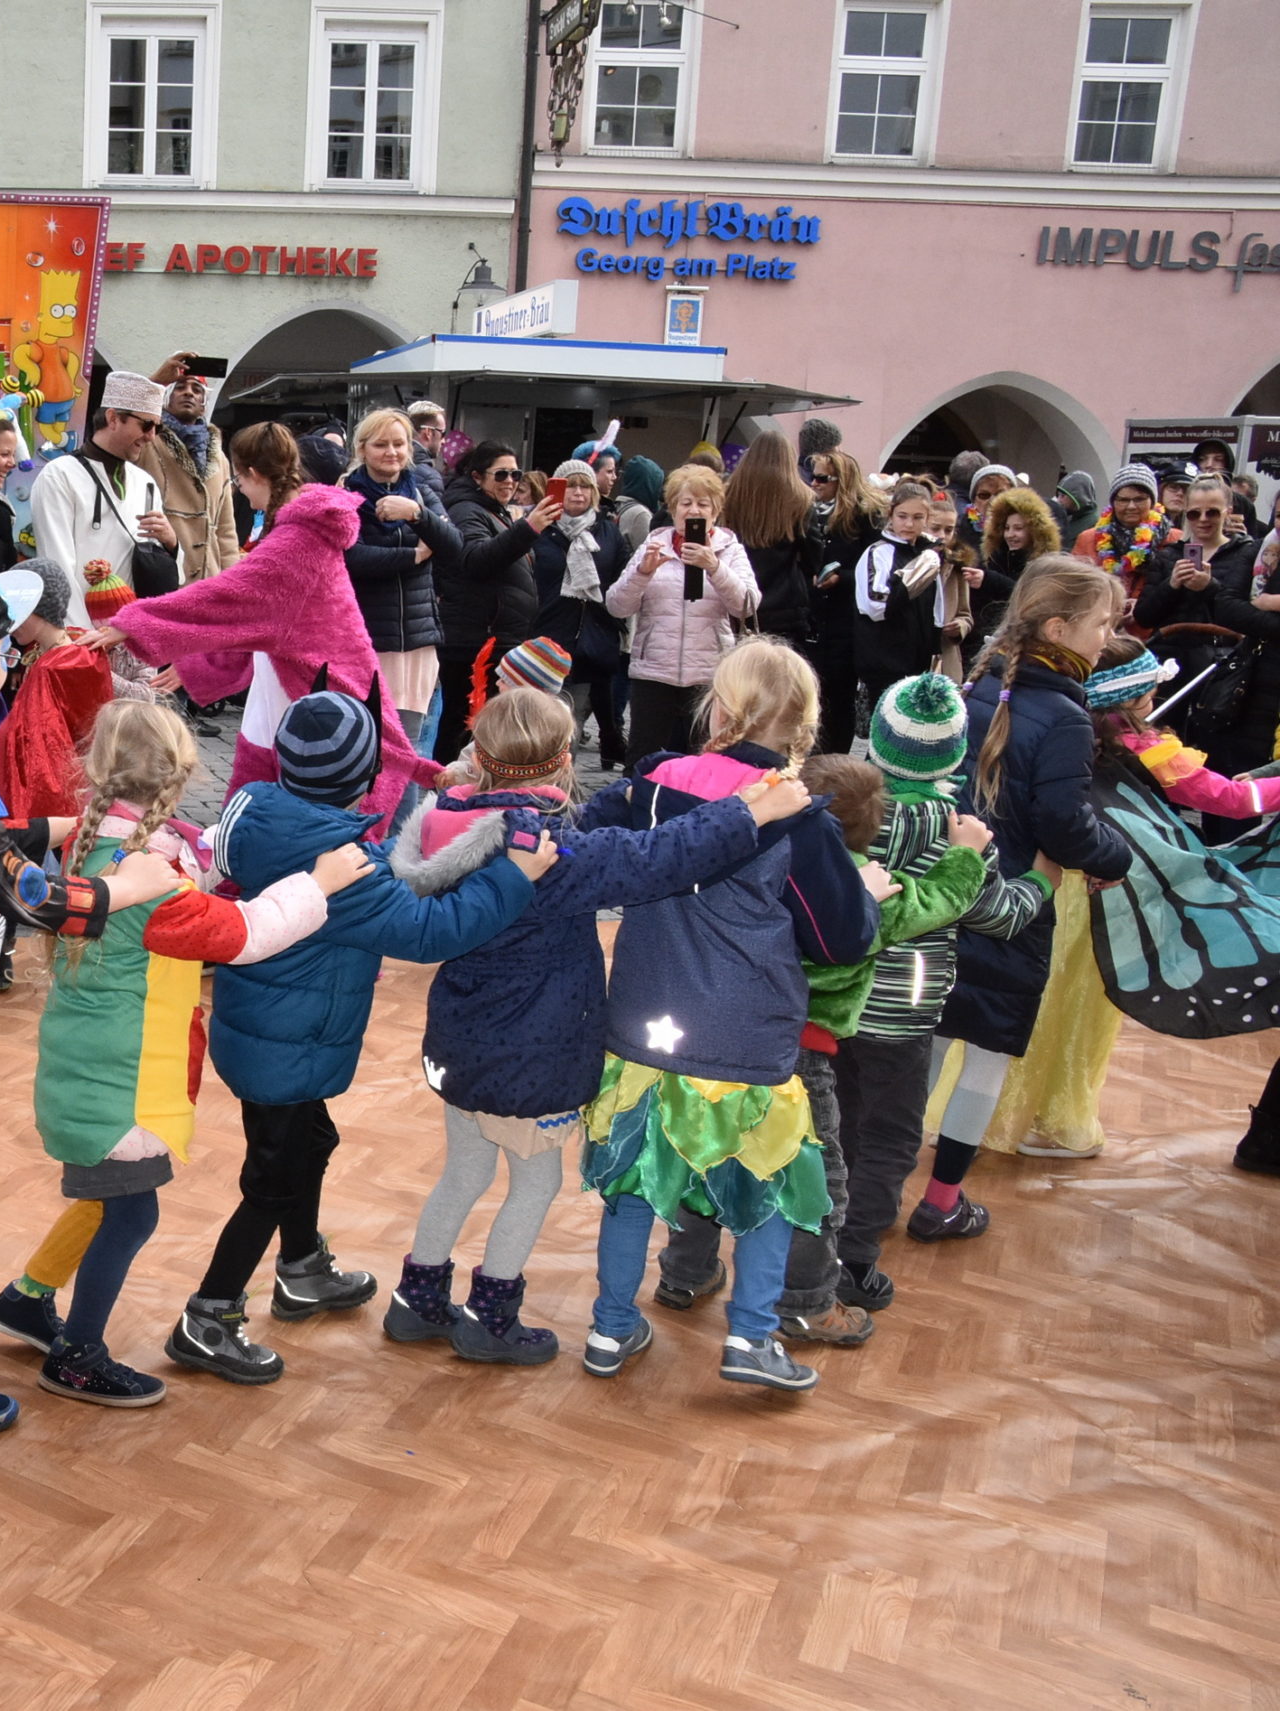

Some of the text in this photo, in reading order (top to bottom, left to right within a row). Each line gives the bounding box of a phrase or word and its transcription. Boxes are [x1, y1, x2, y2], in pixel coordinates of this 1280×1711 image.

[705, 201, 821, 246] Bräu
[104, 242, 378, 278] EF APOTHEKE
[575, 248, 798, 281] Georg am Platz
[1037, 226, 1221, 273] IMPULS
